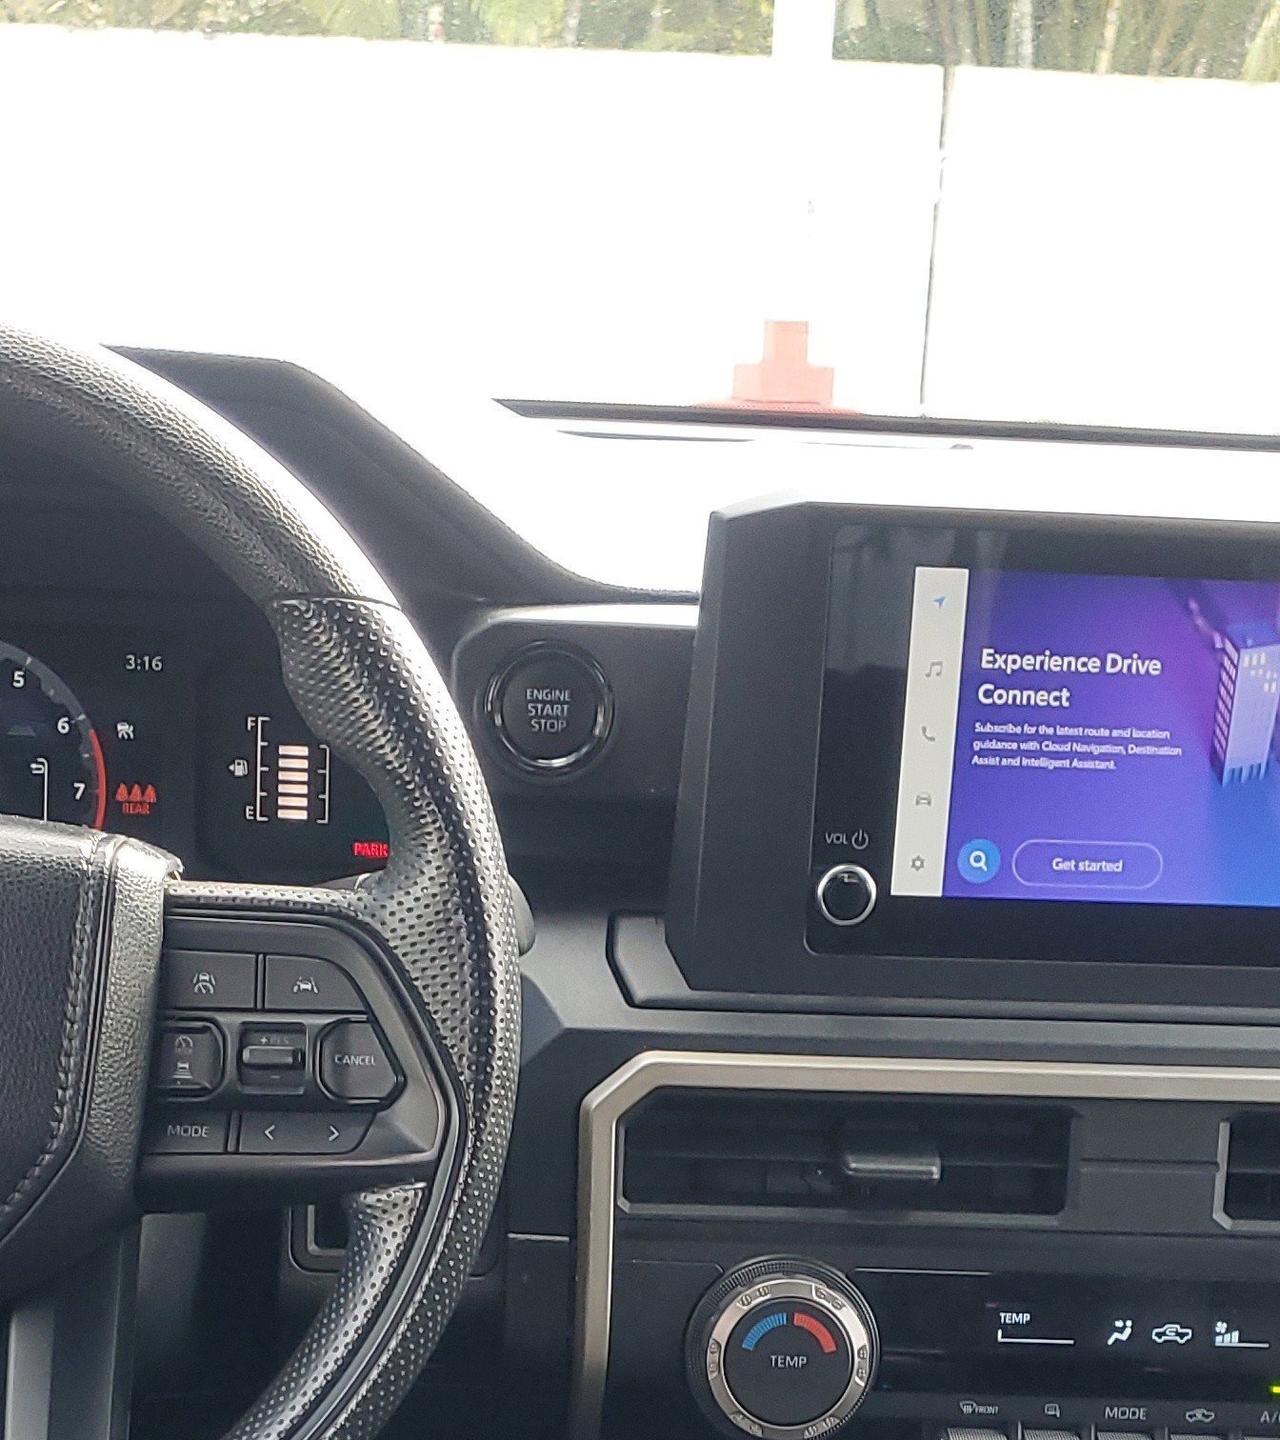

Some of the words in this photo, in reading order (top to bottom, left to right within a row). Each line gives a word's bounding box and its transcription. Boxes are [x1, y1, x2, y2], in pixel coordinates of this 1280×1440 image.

[124, 654, 163, 673] 3:16
[980, 647, 1101, 675] Experience
[1105, 652, 1162, 676] Drive
[11, 671, 25, 688] 5
[526, 688, 572, 702] ENGINE
[977, 682, 1071, 708] Connect
[527, 703, 569, 717] START
[56, 716, 70, 734] 6
[246, 716, 257, 732] F
[530, 718, 567, 733] STOP
[974, 722, 1022, 734] Subscribe
[1023, 723, 1037, 735] for
[1038, 724, 1055, 735] the
[1056, 724, 1083, 736] latest
[1084, 727, 1110, 737] route
[1111, 726, 1131, 738] and
[1132, 728, 1171, 740] location
[973, 738, 1018, 751] guidance
[1020, 740, 1040, 751] with
[1042, 740, 1071, 752] Cloud
[1072, 742, 1126, 755] Navigation,
[1128, 744, 1182, 756] Destination
[971, 755, 1000, 766] Assist
[1001, 755, 1020, 766] and
[1021, 756, 1070, 770] Intelligent
[1071, 758, 1117, 770] Assistant.
[73, 782, 86, 800] 7
[121, 801, 151, 815] REAR
[245, 805, 255, 820] E
[824, 832, 848, 845] VOL
[352, 842, 389, 858] PARK
[1051, 857, 1076, 872] Get
[1078, 858, 1123, 873] started
[334, 1052, 377, 1067] CANCEL
[166, 1123, 211, 1139] MODE
[999, 1312, 1030, 1325] TEMP
[770, 1354, 808, 1369] TEMP
[974, 1403, 1000, 1415] FRONT
[1104, 1406, 1147, 1420] MODE
